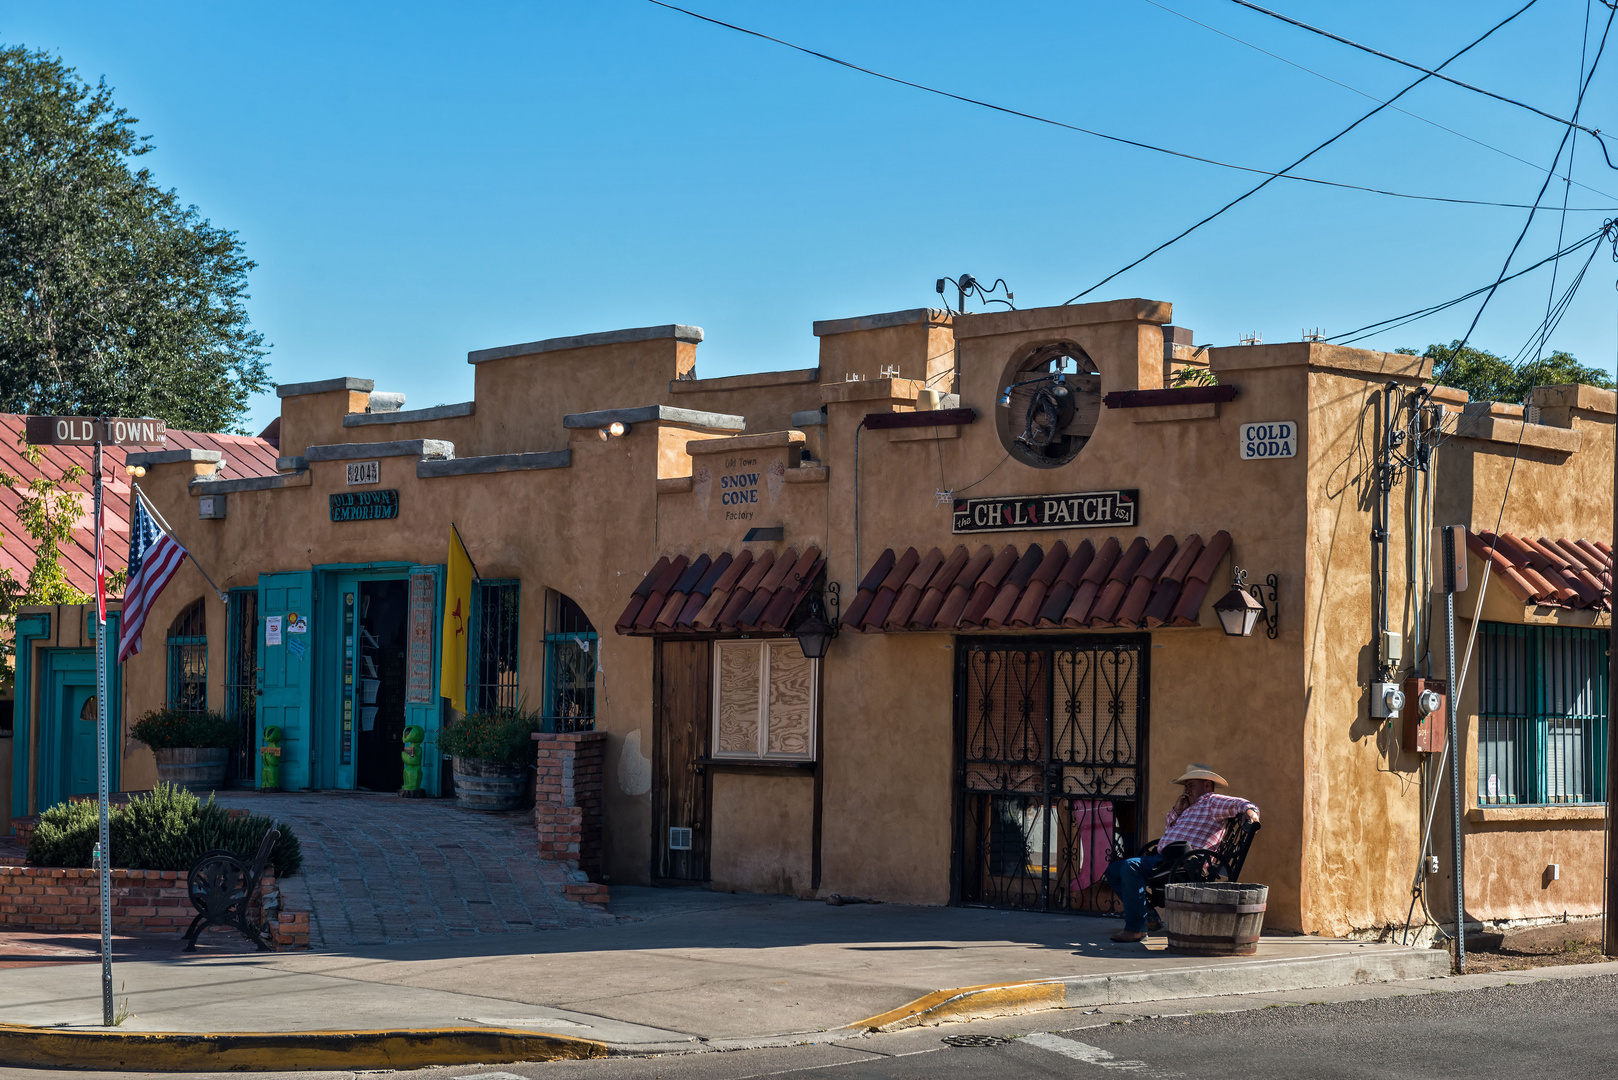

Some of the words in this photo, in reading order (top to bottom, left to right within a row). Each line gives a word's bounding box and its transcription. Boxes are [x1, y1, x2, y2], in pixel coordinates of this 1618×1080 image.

[57, 420, 93, 441] OLD
[105, 421, 154, 442] TOWN
[156, 422, 166, 433] RD
[1246, 424, 1291, 441] COLD
[1246, 441, 1292, 457] SODA
[739, 457, 757, 467] Town
[354, 464, 371, 482] 204
[720, 473, 761, 489] SNOW
[334, 493, 354, 507] OLD
[357, 491, 391, 506] TOWN
[721, 489, 759, 506] CONE
[334, 504, 392, 521] EMPORIUM
[725, 511, 754, 521] Factory
[1042, 497, 1114, 524] PATCH
[1114, 507, 1130, 521] USA
